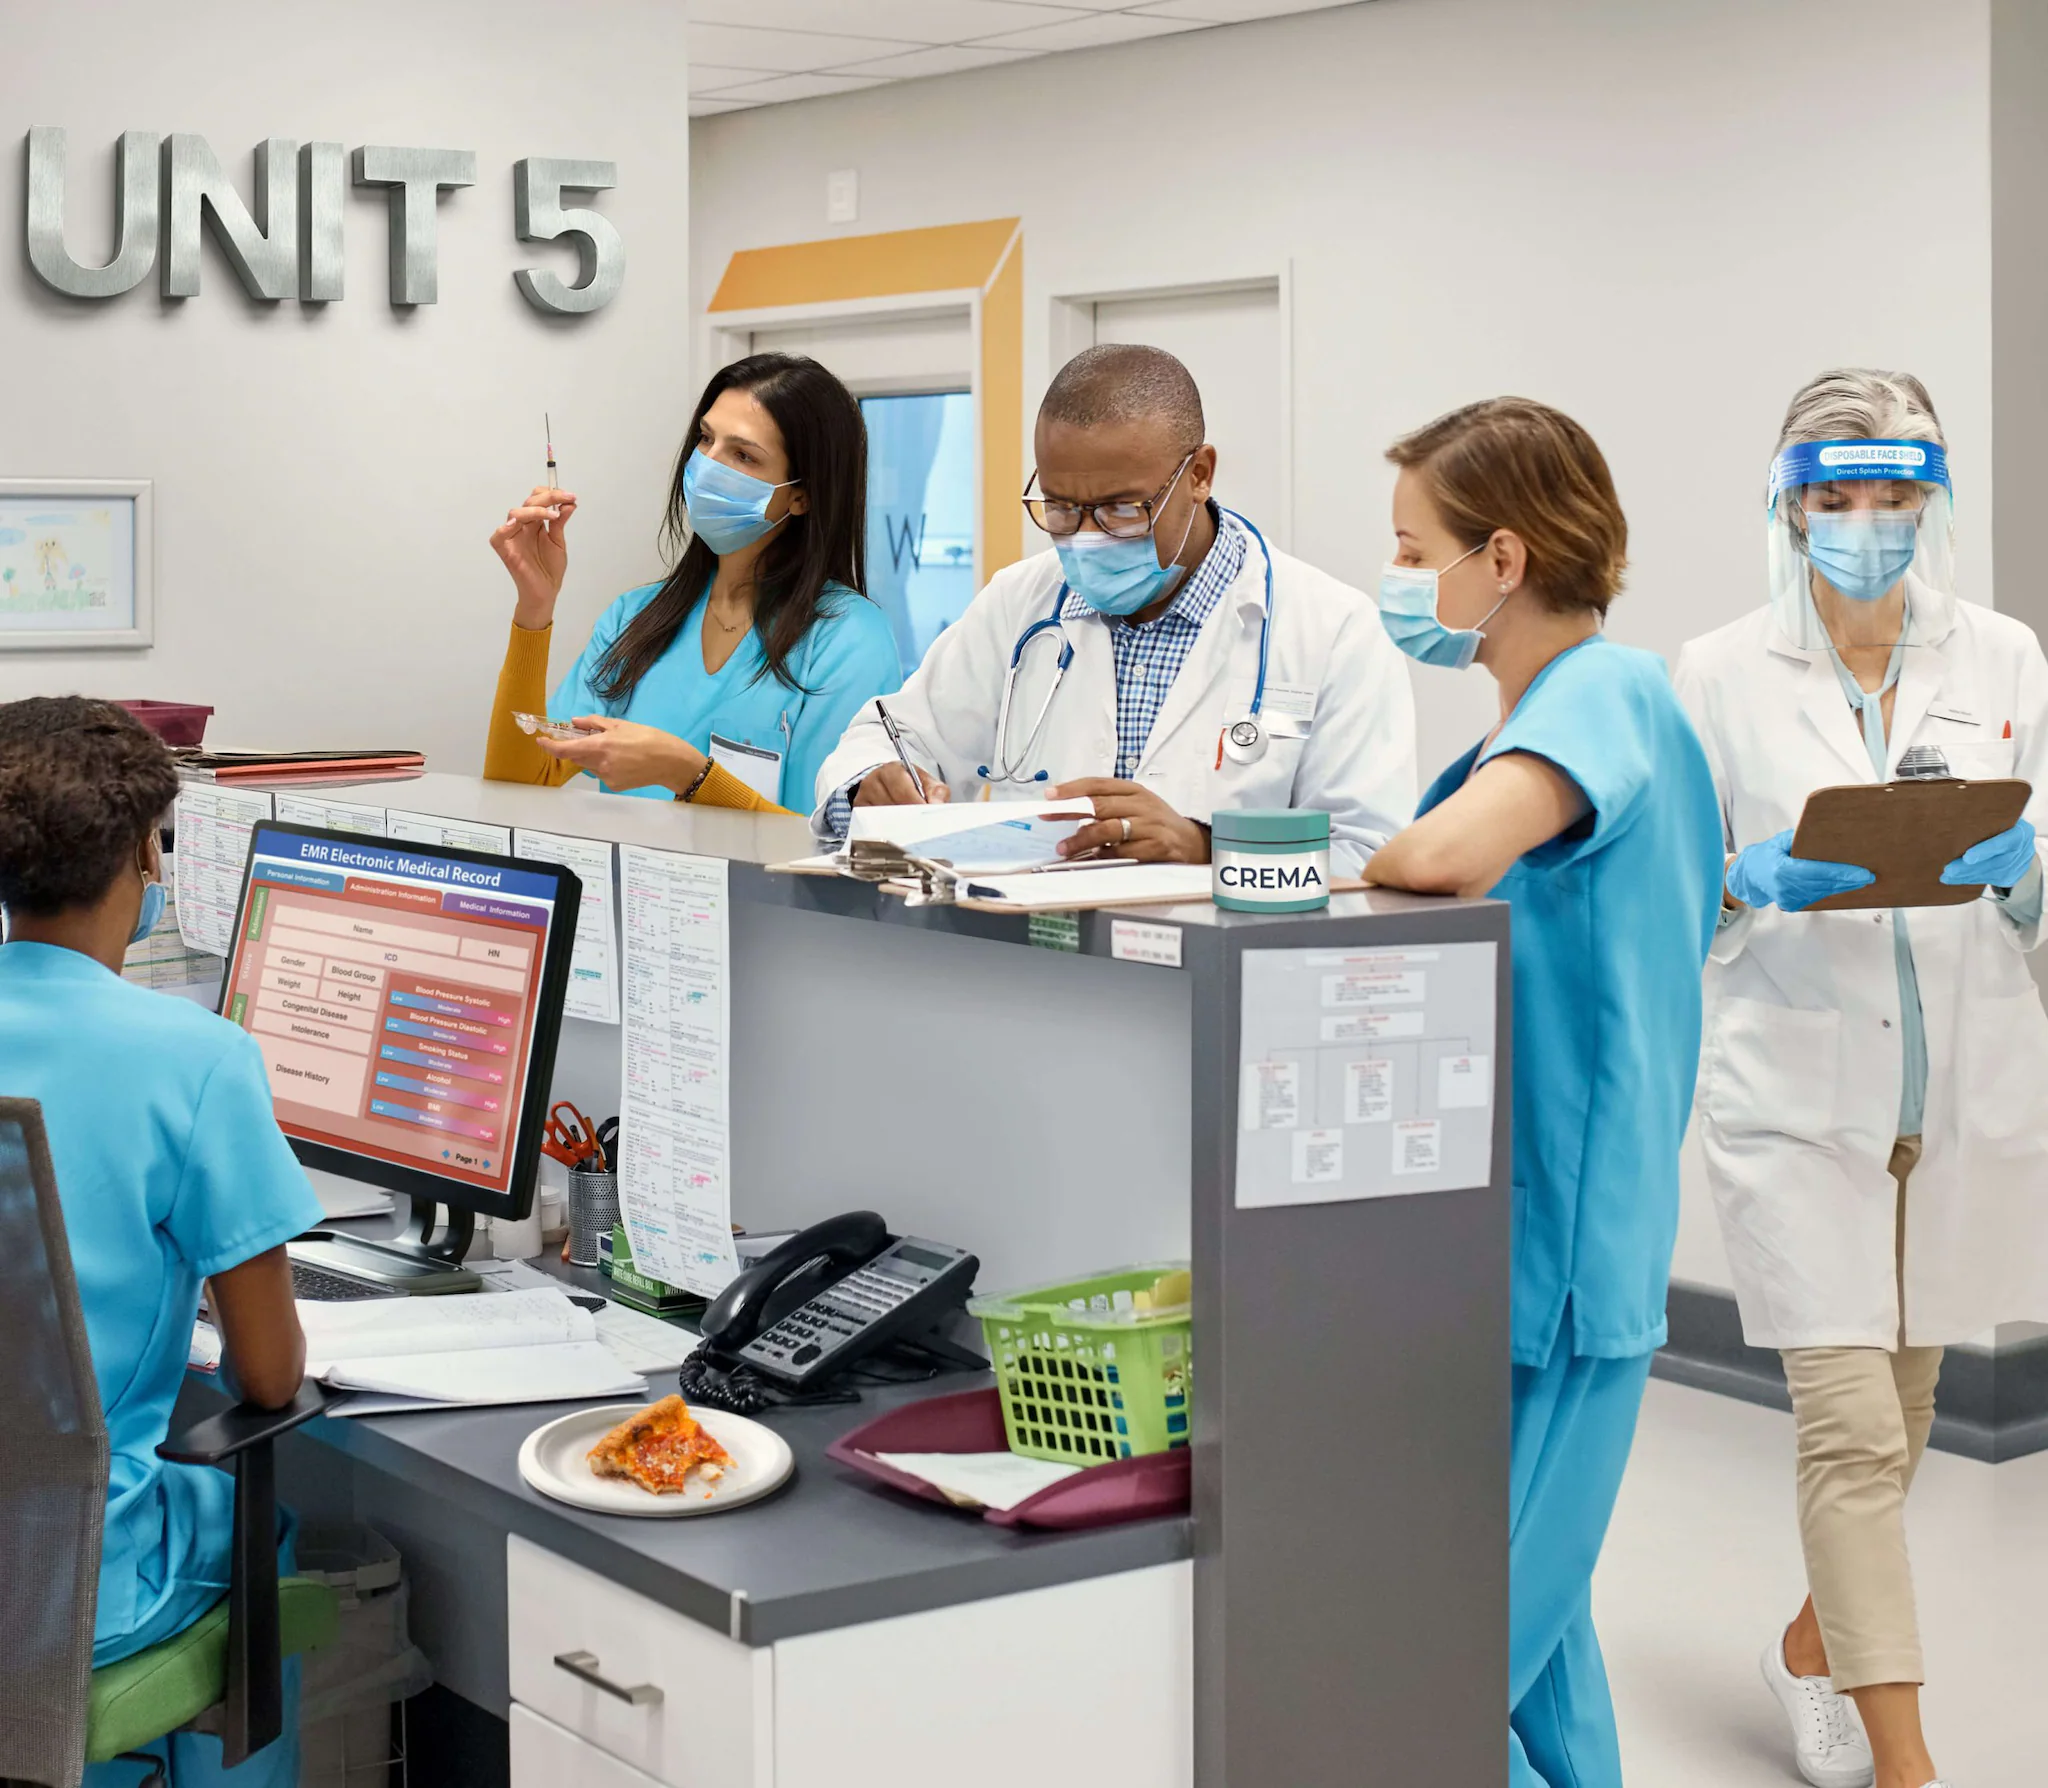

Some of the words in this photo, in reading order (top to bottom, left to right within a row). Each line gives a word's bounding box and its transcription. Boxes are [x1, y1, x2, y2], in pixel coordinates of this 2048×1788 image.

[25, 125, 476, 305] UNIT
[513, 156, 626, 315] 5
[1824, 450, 1875, 461] DISPOSABLE
[1877, 449, 1897, 460] FACE
[1899, 450, 1923, 462] SHIELD
[1836, 468, 1858, 476] Direct
[1859, 467, 1882, 476] Splash
[1884, 467, 1915, 477] Protection
[300, 843, 329, 860] EMR
[331, 848, 395, 871] Electronic
[396, 858, 450, 880] Medical
[452, 867, 502, 887] Record
[267, 869, 294, 880] Personal
[295, 874, 330, 886] Information
[1219, 865, 1322, 889] CREMA
[350, 883, 397, 897] Administration
[398, 890, 437, 904] Information
[251, 891, 265, 935] Admission
[459, 900, 487, 912] Medical
[489, 905, 531, 919] Information
[353, 924, 374, 935] Name
[280, 956, 306, 967] Gender
[384, 952, 398, 962] ICD
[488, 948, 500, 958] HN
[277, 977, 302, 989] Weight
[331, 966, 352, 977] Blood
[353, 971, 377, 983] Group
[337, 990, 361, 1002] Height
[415, 985, 434, 996] Blood
[435, 989, 463, 1001] Pressure
[464, 995, 491, 1007] Systolic
[282, 999, 319, 1015] Congenital
[320, 1008, 348, 1021] Disease
[409, 1012, 429, 1022] Blood
[430, 1016, 458, 1029] Pressure
[291, 1023, 330, 1039] Intolerance
[418, 1042, 446, 1056] Smoking
[447, 1048, 468, 1060] Status
[276, 1064, 303, 1077] Disease
[304, 1072, 330, 1085] History
[426, 1073, 451, 1085] Alcohol
[455, 1153, 473, 1164] Page
